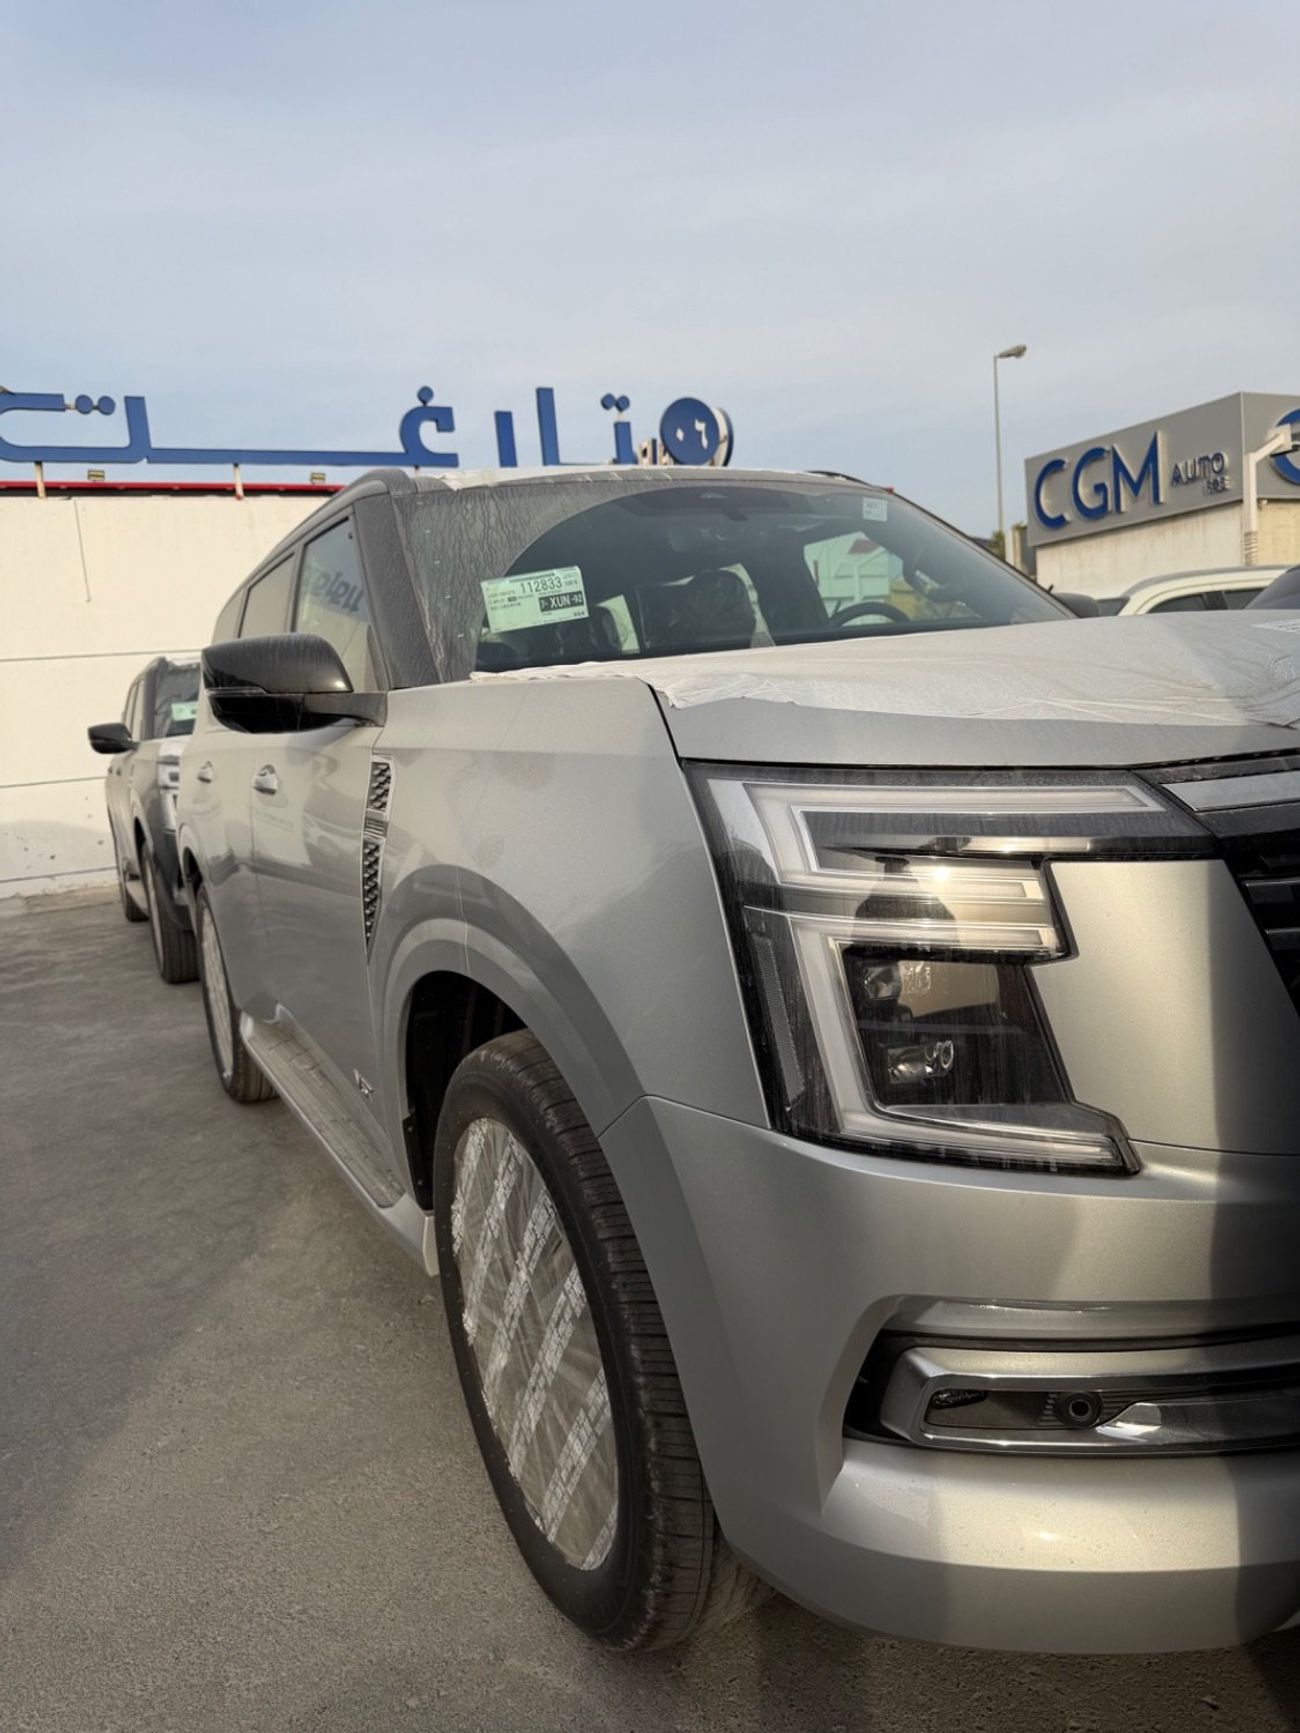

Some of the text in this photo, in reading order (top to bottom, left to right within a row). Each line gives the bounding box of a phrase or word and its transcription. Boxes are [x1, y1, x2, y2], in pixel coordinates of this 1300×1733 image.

[1034, 430, 1227, 529] CGM AUTO
[520, 575, 563, 594] 112833
[550, 595, 571, 609] XUN
